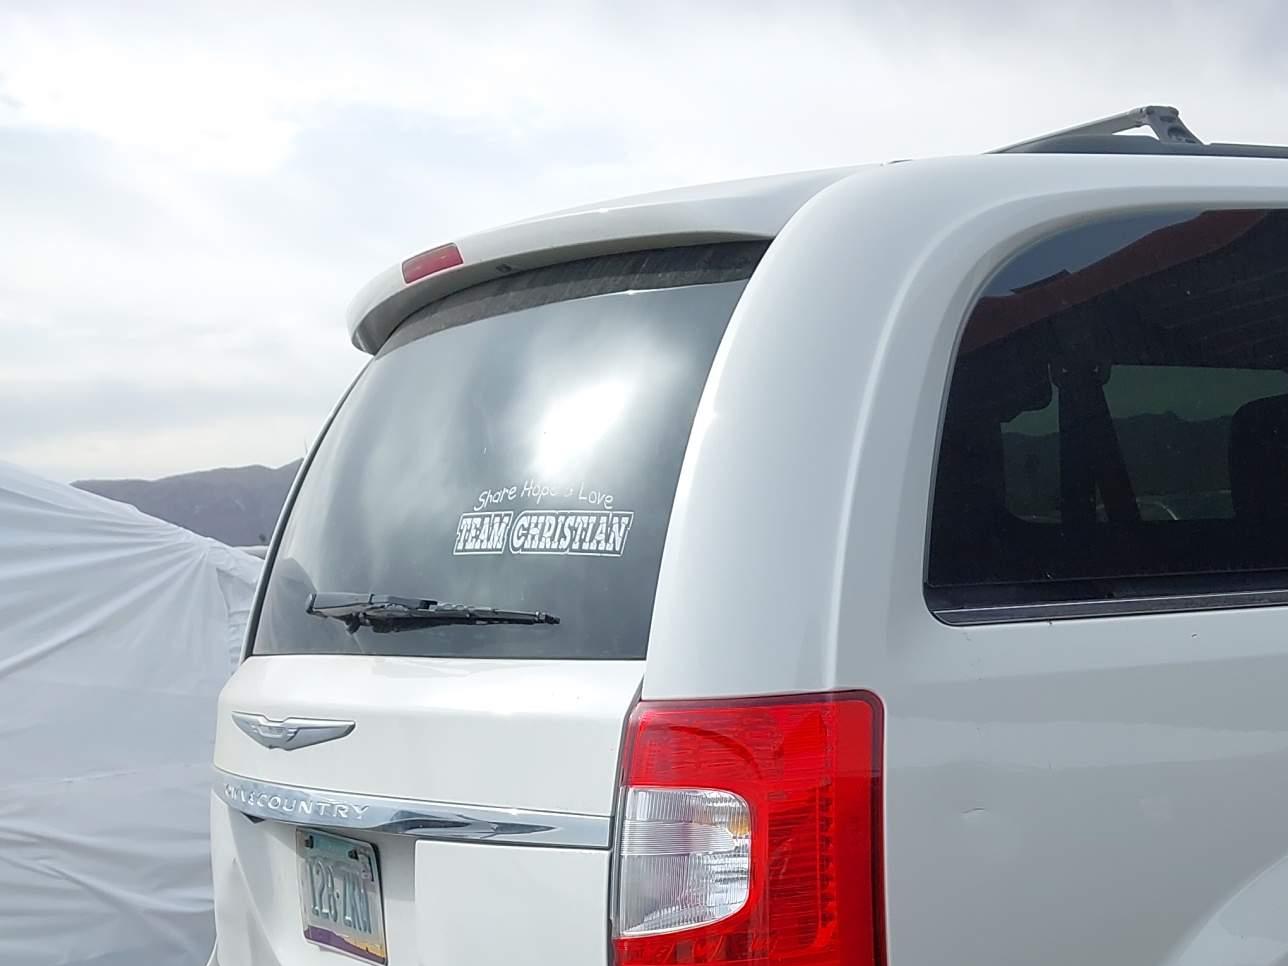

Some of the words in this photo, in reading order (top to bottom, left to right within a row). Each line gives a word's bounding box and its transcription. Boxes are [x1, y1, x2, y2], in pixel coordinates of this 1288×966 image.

[474, 485, 517, 511] Share
[579, 483, 613, 510] Love
[457, 516, 509, 550] TEAM
[514, 516, 628, 551] CHRISTIAN
